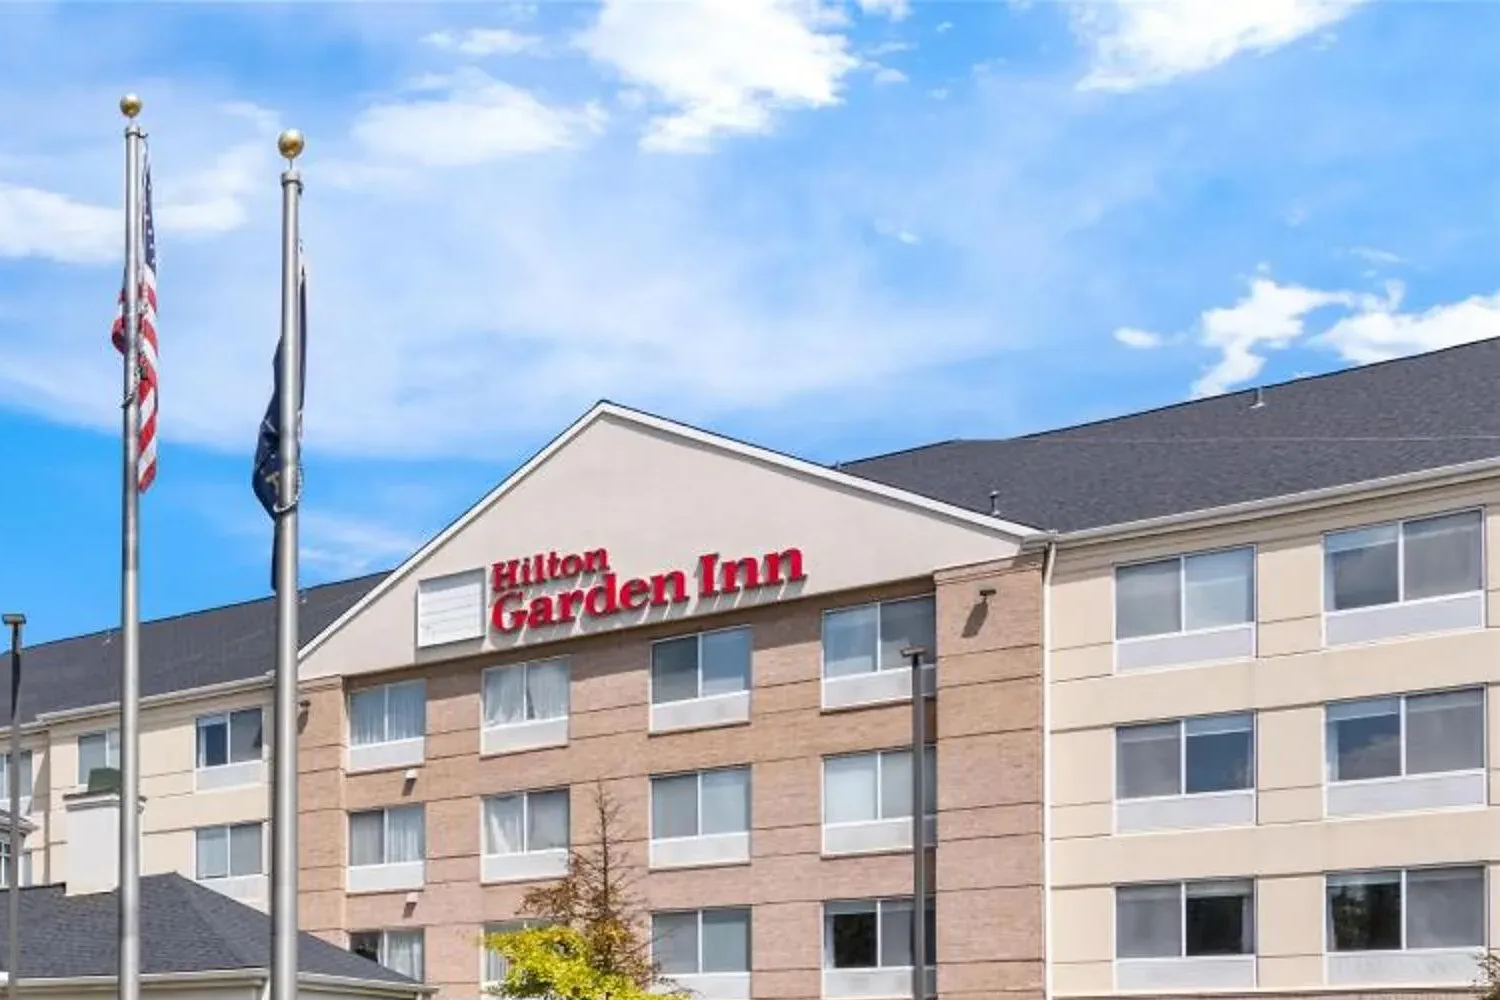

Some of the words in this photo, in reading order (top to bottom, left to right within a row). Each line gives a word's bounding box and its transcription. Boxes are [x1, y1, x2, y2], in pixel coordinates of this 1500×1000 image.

[490, 569, 690, 633] Garden
[699, 546, 807, 598] Inn
[491, 547, 610, 592] Hilton
